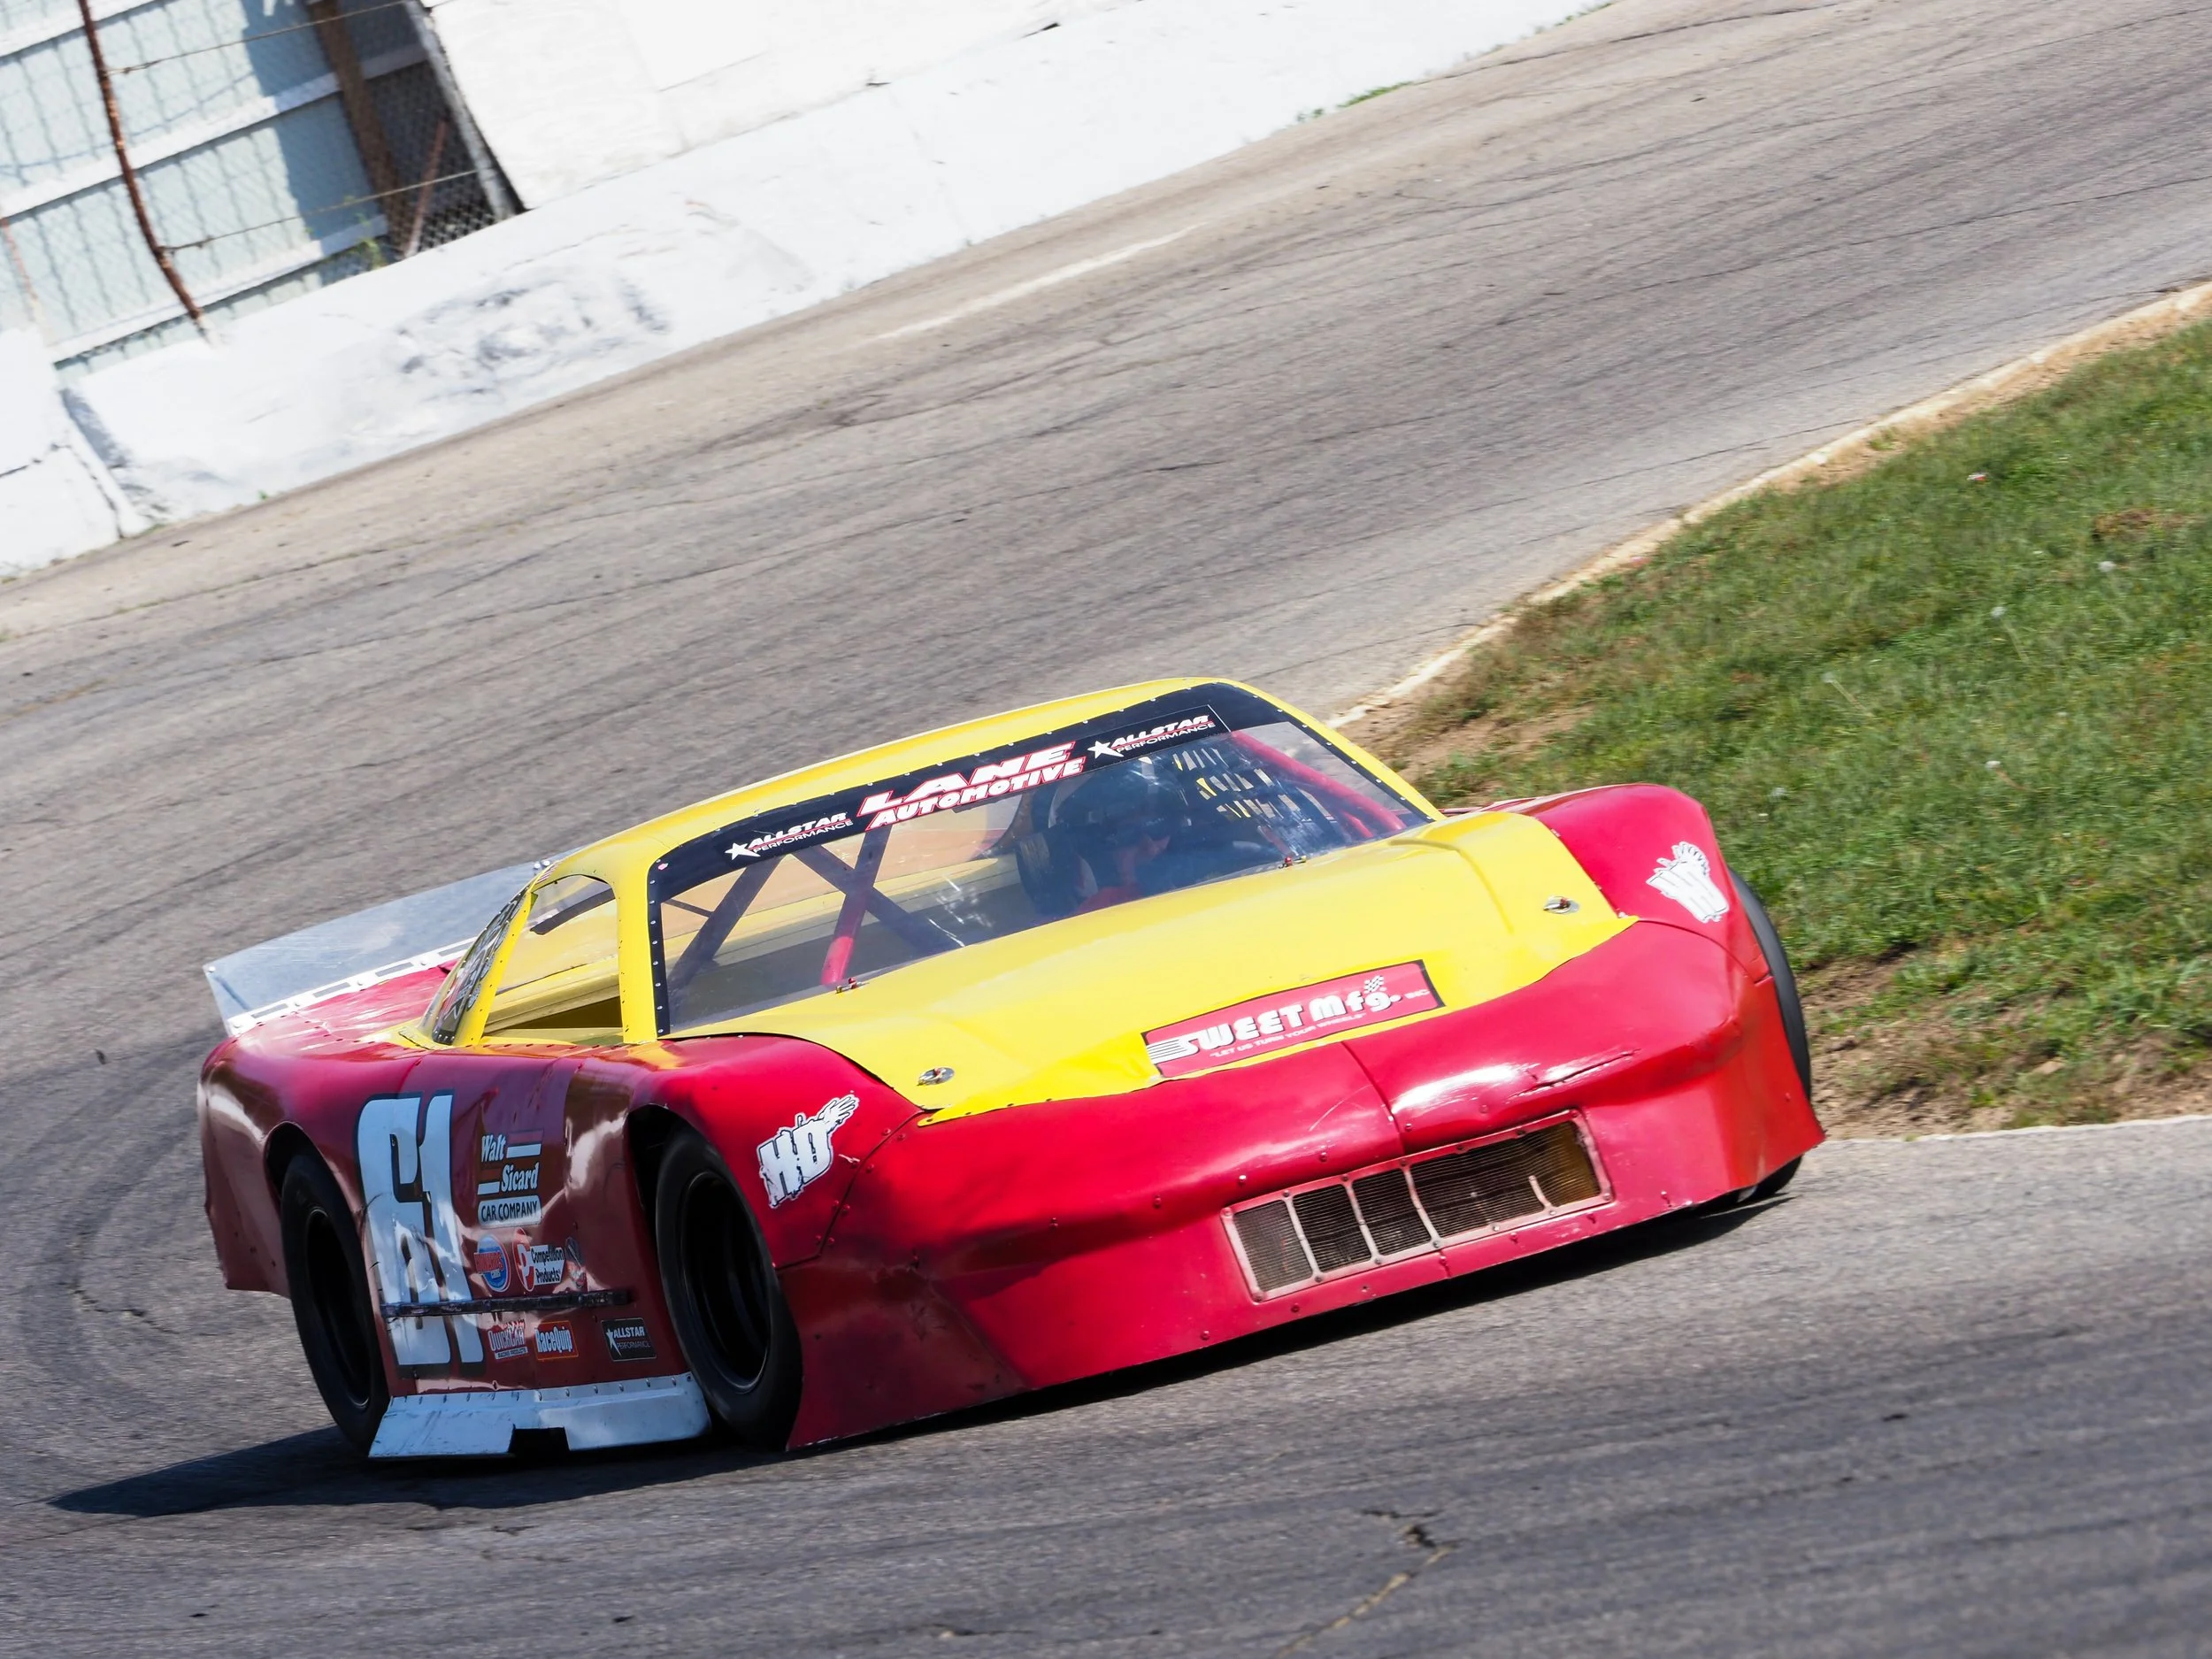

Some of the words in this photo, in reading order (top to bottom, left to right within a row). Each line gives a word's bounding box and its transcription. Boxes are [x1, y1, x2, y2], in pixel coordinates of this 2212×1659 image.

[1110, 714, 1210, 748] ALLSTAR
[1117, 723, 1217, 753] PERFORMANCE
[856, 741, 1076, 817] LANE
[865, 757, 1087, 832] AUTOMOTIVE
[748, 811, 848, 849] ALLSTAR
[753, 820, 854, 854] PERFORMANCE
[1146, 1002, 1305, 1065] SWEET
[480, 1133, 507, 1163] Walt
[501, 1162, 540, 1193] Sicard
[480, 1204, 497, 1223] CAR
[498, 1200, 538, 1221] COMPANY
[531, 1247, 565, 1266] Competition
[534, 1325, 573, 1354] RaceQuip
[612, 1325, 645, 1339] ALLSTAR
